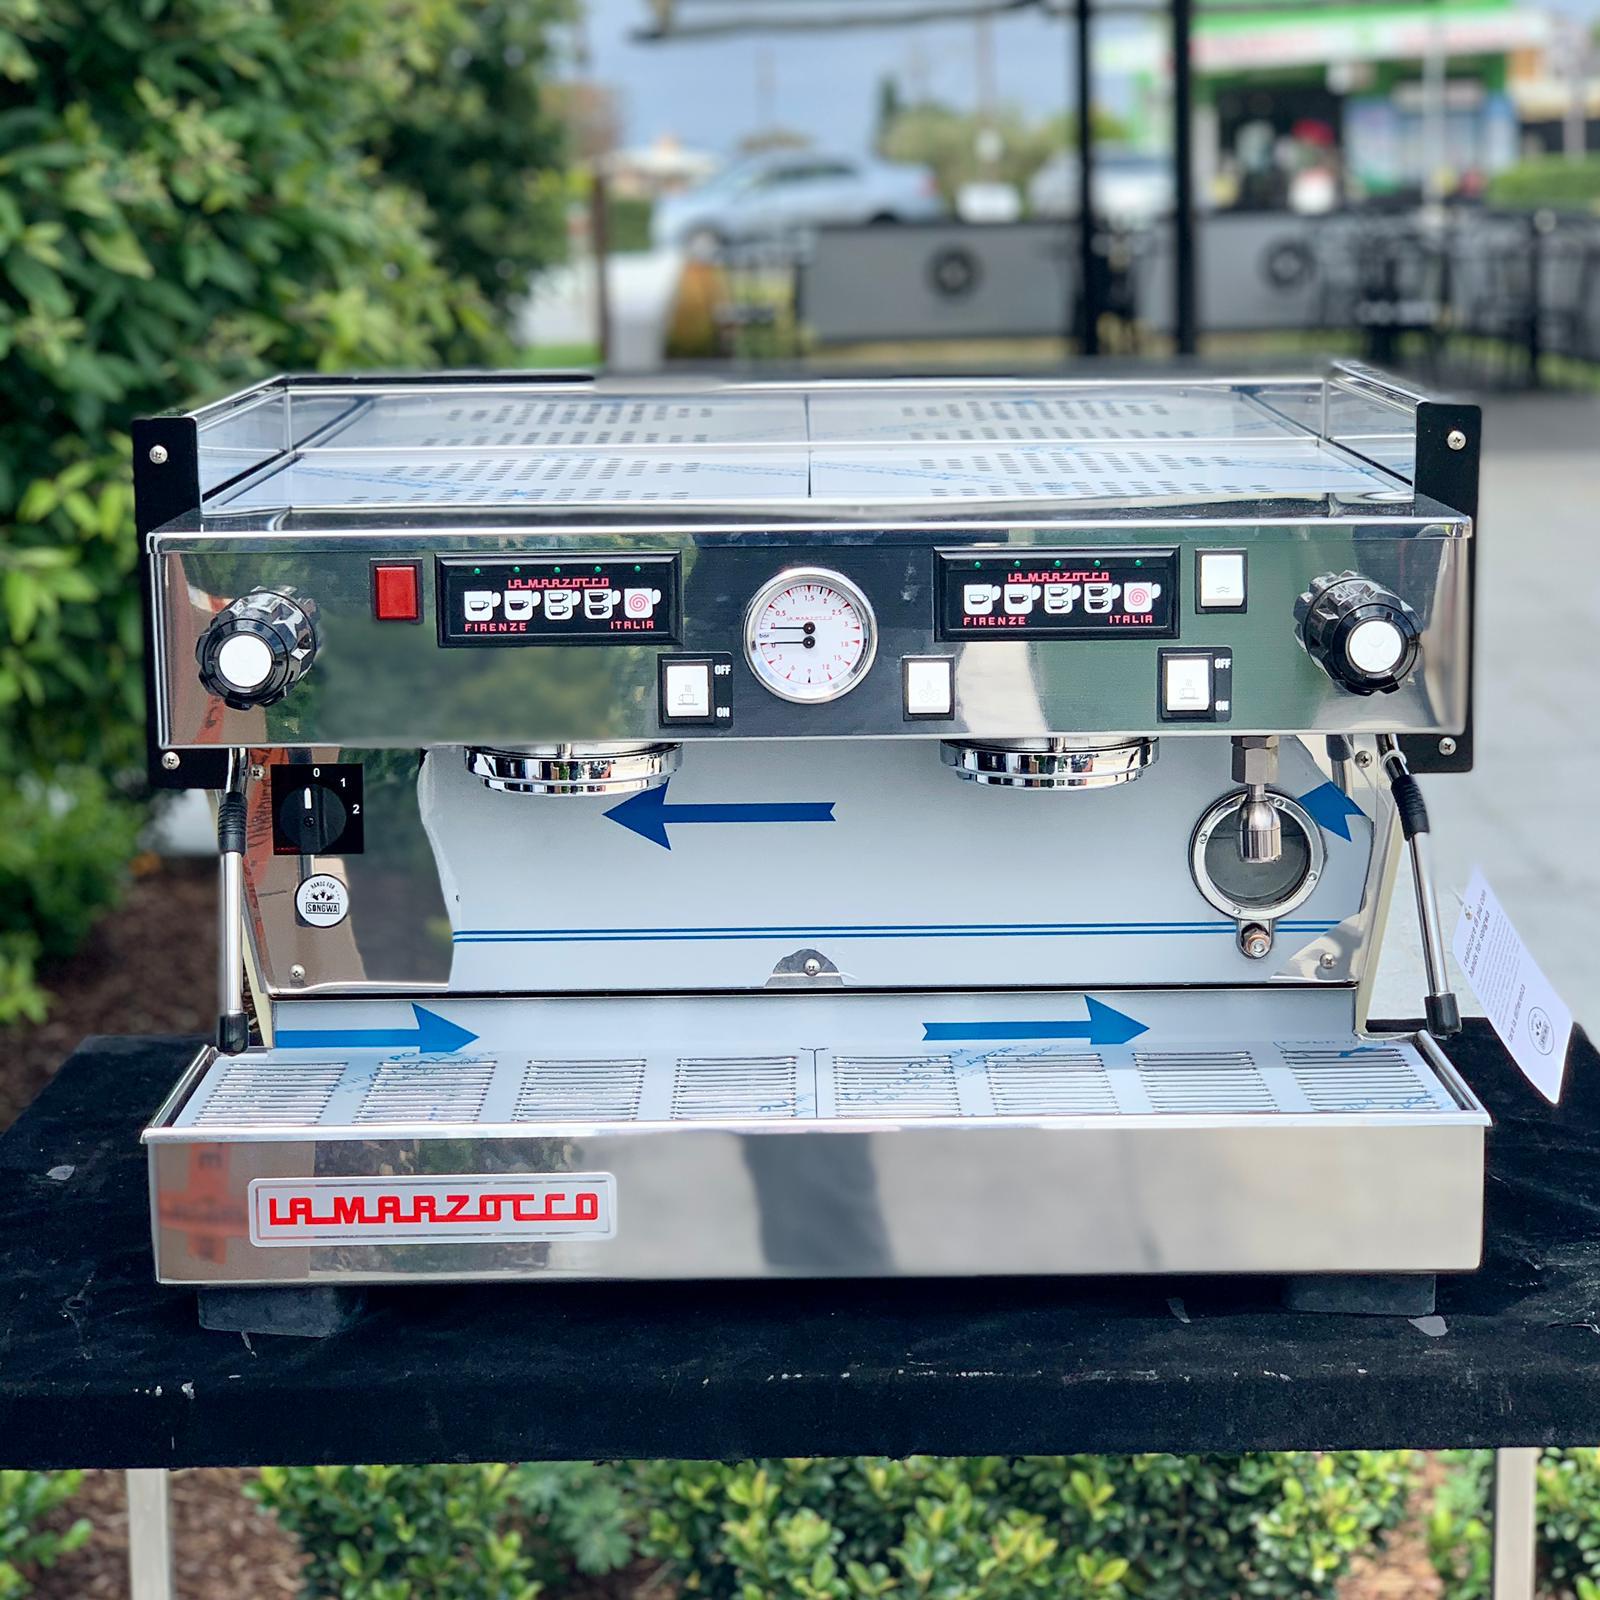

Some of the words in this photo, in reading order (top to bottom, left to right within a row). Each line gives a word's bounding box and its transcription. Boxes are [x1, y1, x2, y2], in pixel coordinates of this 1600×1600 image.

[963, 616, 1026, 626] FIRENZE
[1109, 614, 1153, 624] ITALIA
[465, 622, 527, 632] FIRENZE
[610, 620, 655, 630] ITALIA
[1214, 658, 1231, 669] OFF
[714, 664, 731, 675] OFF
[1215, 700, 1229, 711] ON
[716, 707, 730, 717] ON
[313, 768, 320, 778] 0
[340, 777, 346, 788] 1
[352, 804, 360, 815] 2
[307, 903, 338, 913] SONGWA
[269, 1197, 312, 1226] LA
[333, 1193, 599, 1225] MARZOCCO
